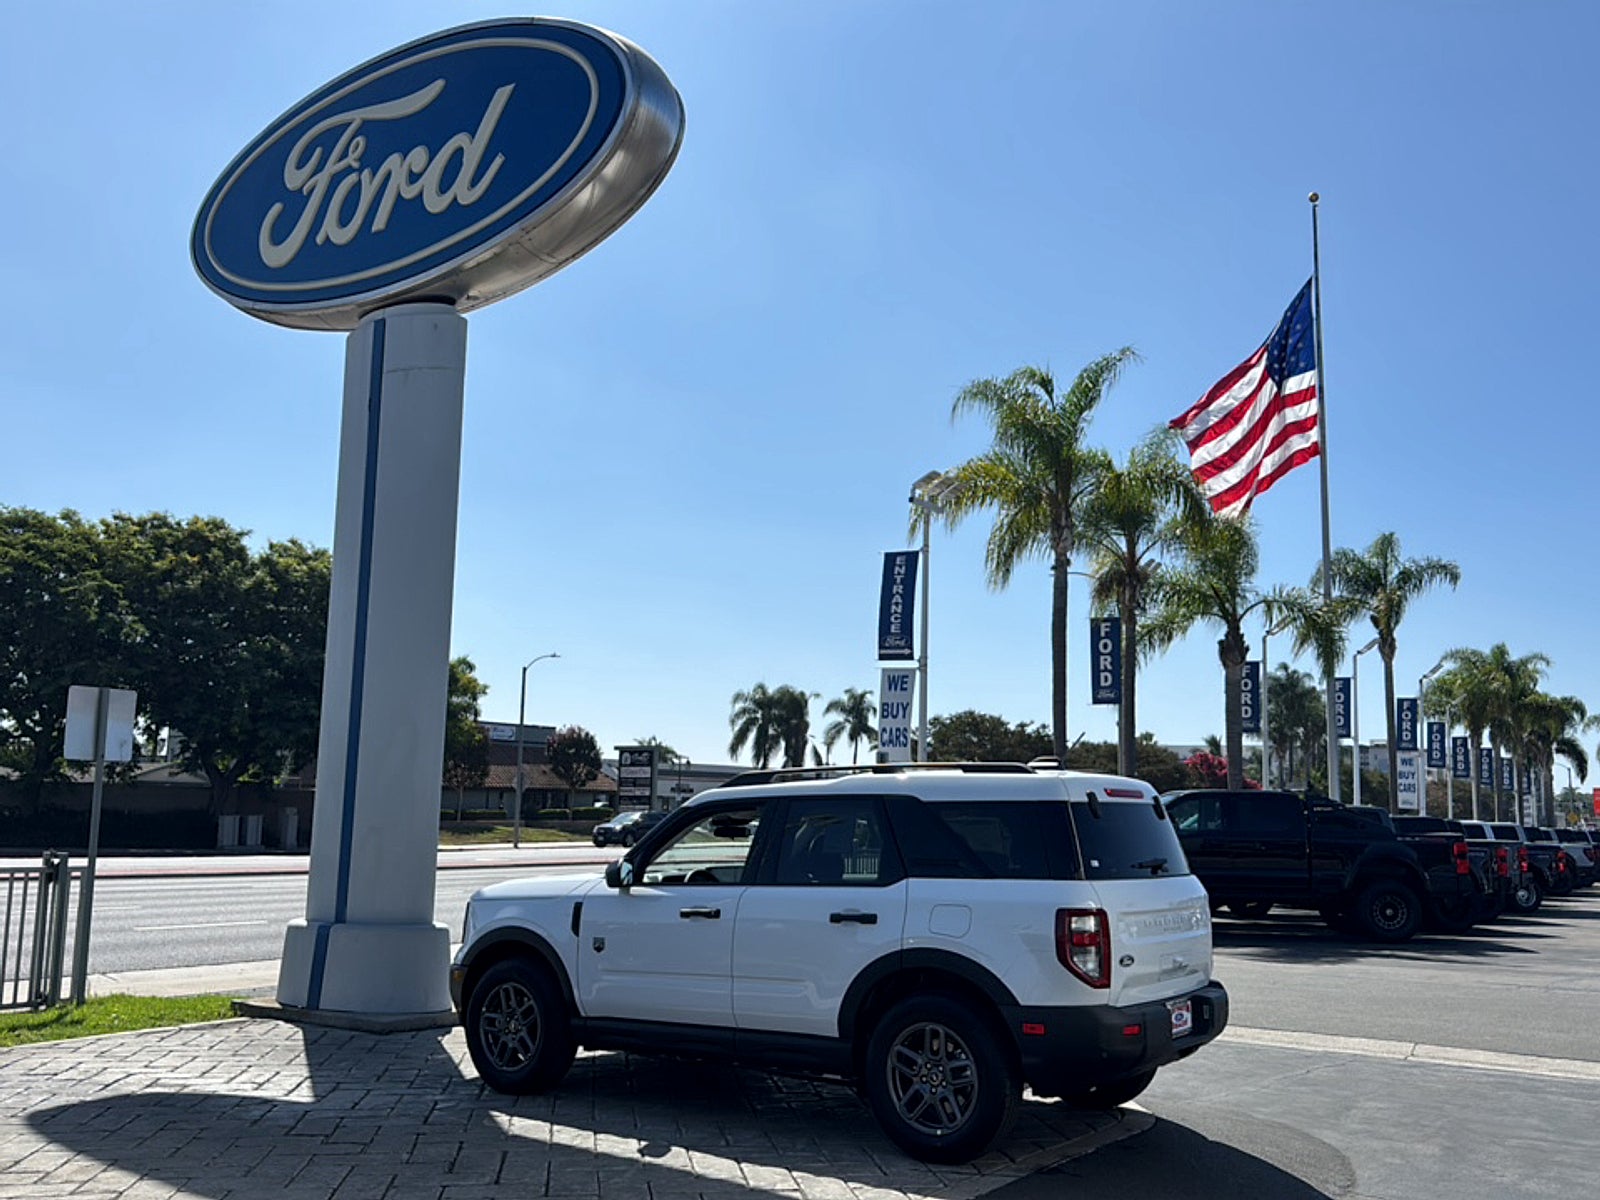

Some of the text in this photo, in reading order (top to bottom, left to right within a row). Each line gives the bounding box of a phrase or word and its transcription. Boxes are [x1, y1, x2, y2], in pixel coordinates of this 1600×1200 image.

[258, 78, 516, 268] Ford
[890, 555, 907, 633] ENTRANCE
[1099, 622, 1113, 687] FORD
[887, 674, 909, 692] WE
[1241, 665, 1253, 718] FORD
[881, 702, 910, 719] BUY
[1335, 680, 1345, 727] FORD
[1402, 700, 1412, 741] FORD
[880, 727, 908, 748] CARS
[1432, 724, 1441, 760] FORD
[1457, 738, 1465, 770] FORD
[1398, 770, 1416, 780] BUY
[1400, 757, 1414, 767] WE
[1398, 782, 1416, 793] CARS
